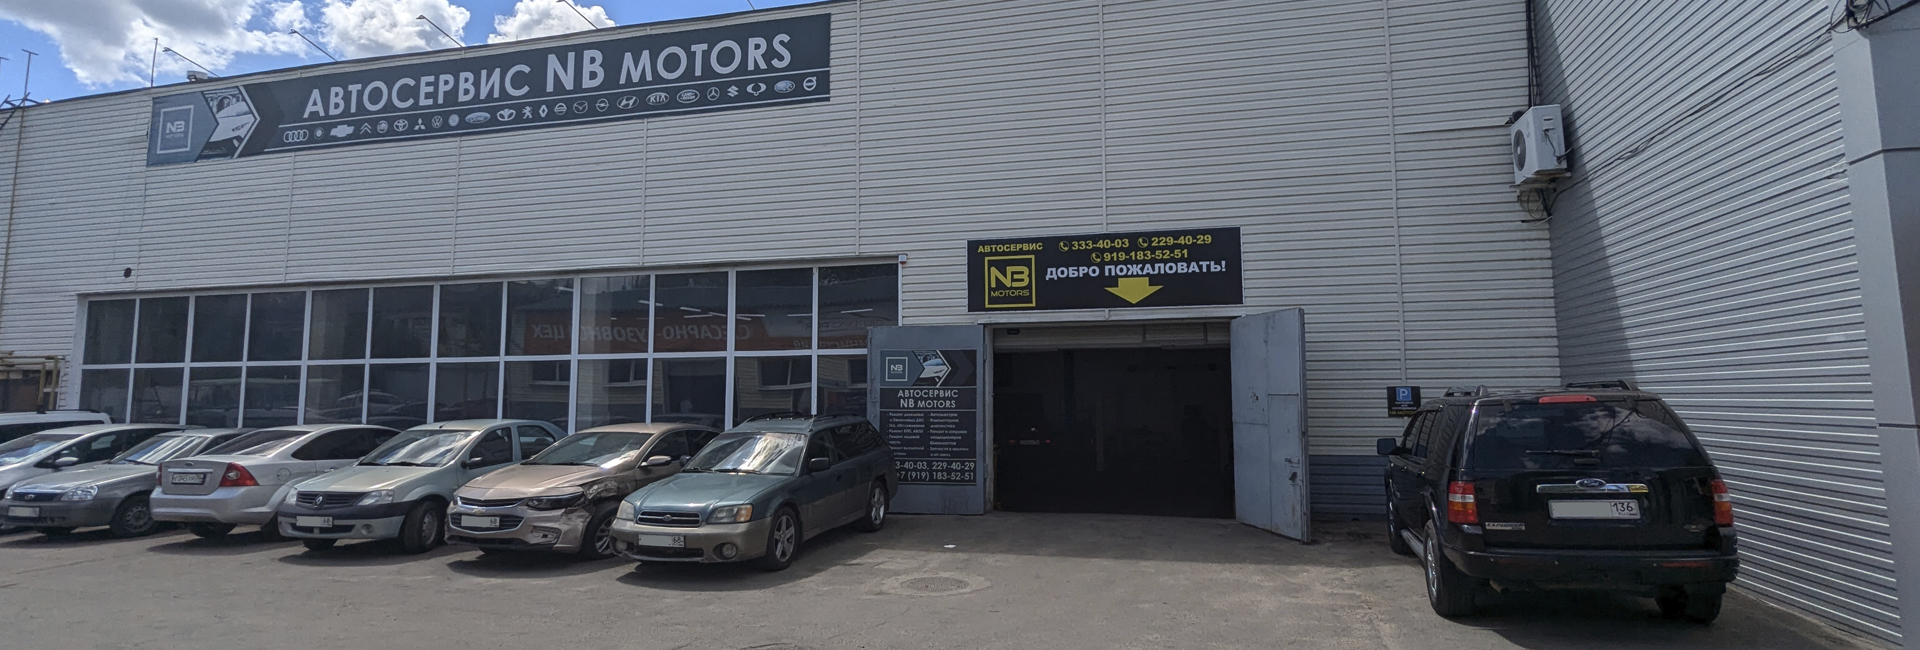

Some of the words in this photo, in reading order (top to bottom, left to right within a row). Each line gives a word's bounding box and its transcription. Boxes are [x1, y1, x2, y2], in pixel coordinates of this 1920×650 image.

[302, 64, 532, 118] АВТОСЕРВИС
[546, 49, 605, 92] NB
[619, 33, 791, 85] MOTORS
[649, 92, 667, 103] KIA
[166, 120, 185, 134] NB
[978, 242, 1043, 253] АВТОСЕРВИС
[1071, 238, 1130, 250] 333-40-03
[1151, 234, 1212, 247] 229-40-29
[1103, 249, 1188, 262] 919-183-52-51
[1045, 266, 1100, 280] ДОБРО
[1104, 260, 1227, 277] ПОЖАЛОВАТЬ!
[990, 265, 1030, 288] NB
[898, 390, 958, 398] АВТОСЕРВИС
[1400, 388, 1408, 400] P
[900, 399, 914, 408] NB
[895, 462, 930, 470] 3-40-03,
[932, 462, 975, 470] 229-40-29
[908, 472, 930, 481] (919)
[933, 472, 974, 480] 183-52-51
[1612, 502, 1634, 512] 136
